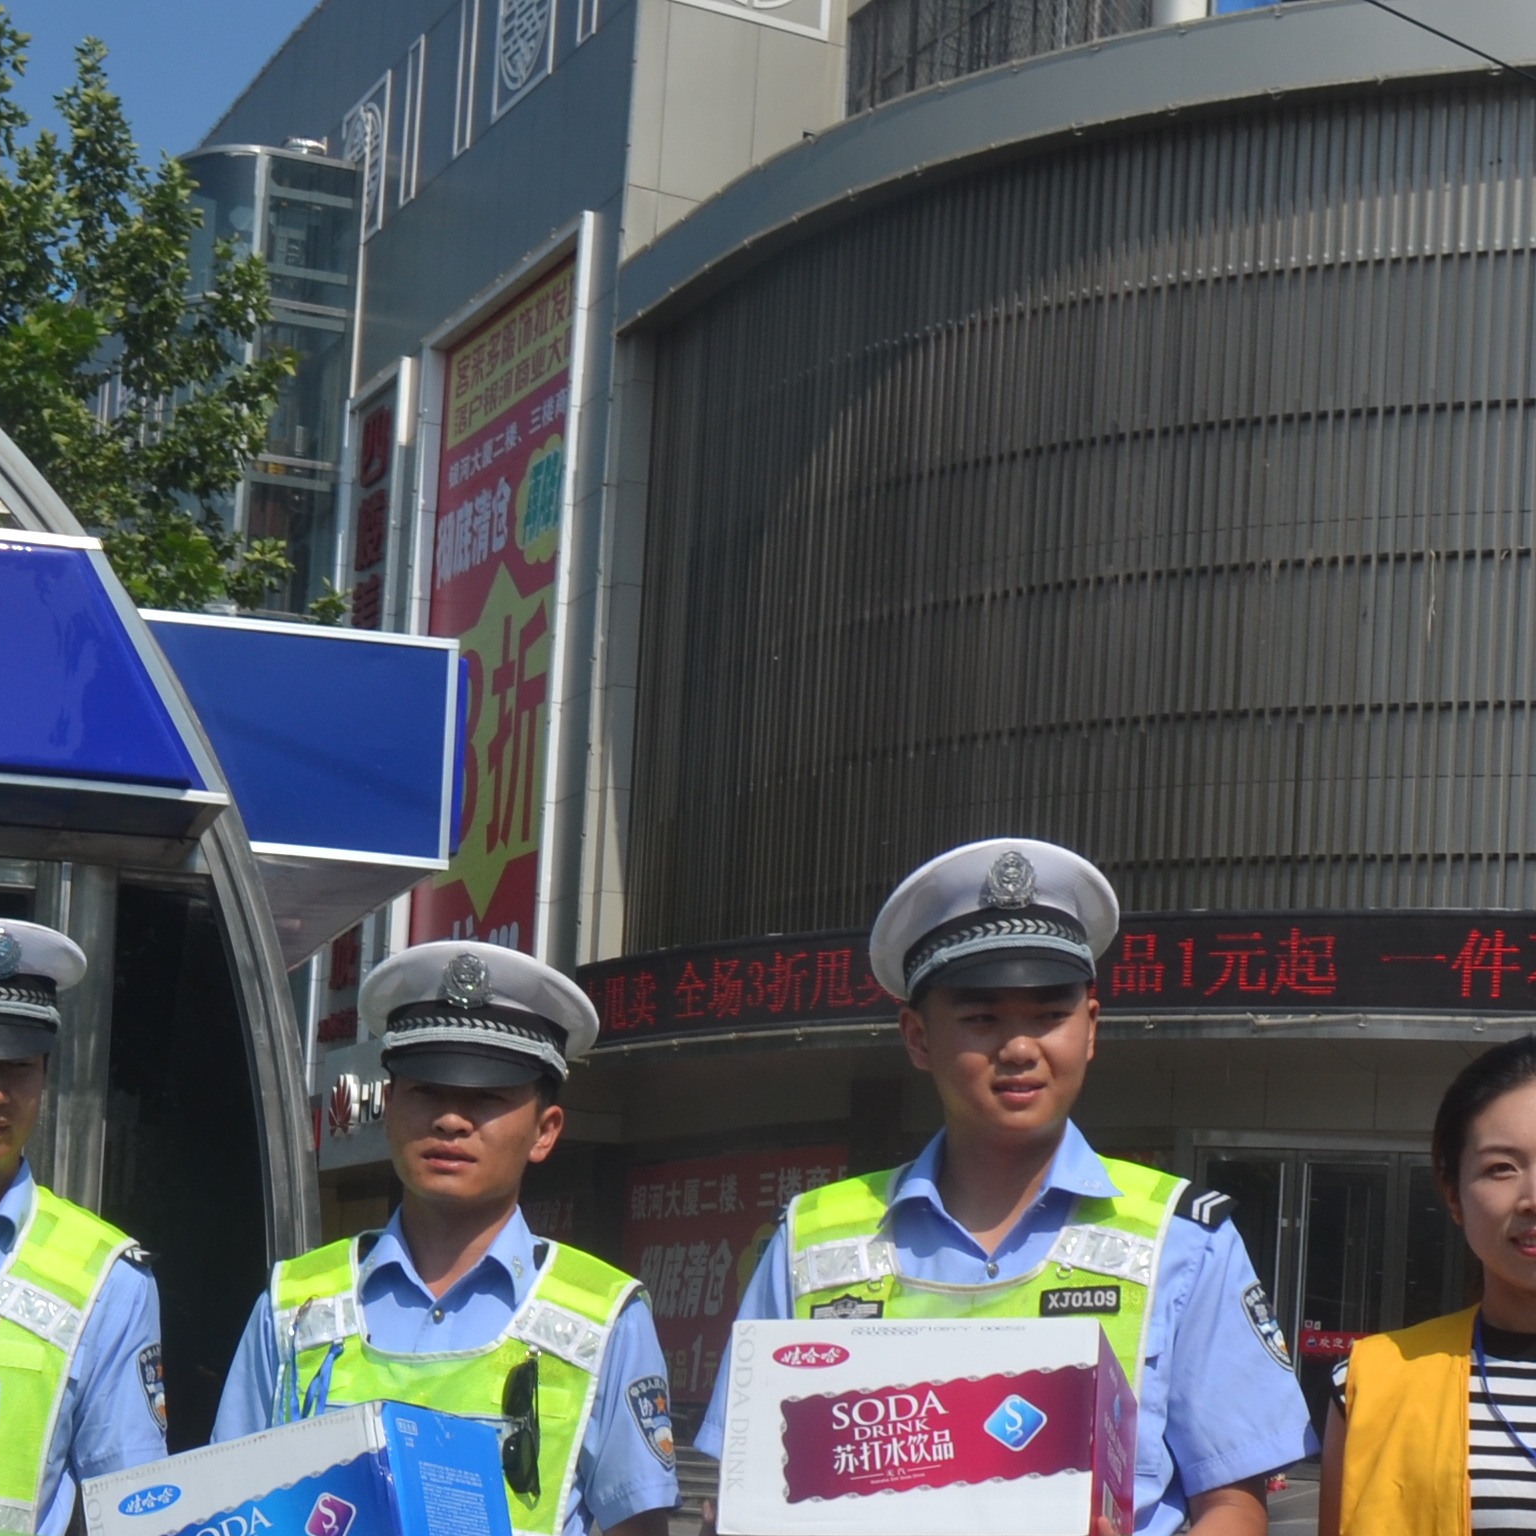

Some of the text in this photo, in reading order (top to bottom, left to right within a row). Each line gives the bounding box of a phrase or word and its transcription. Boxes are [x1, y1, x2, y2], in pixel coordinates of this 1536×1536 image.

[456, 273, 575, 398] 客来多服饰批发
[1047, 1289, 1117, 1311] XJ0109
[780, 1346, 841, 1366] 娃哈哈
[726, 1323, 756, 1491] SODA DRINK
[832, 1389, 949, 1430] SODA
[854, 1418, 931, 1441] DRINK
[831, 1429, 955, 1475] 苏打水饮品
[125, 1486, 175, 1514] 娃哈哈
